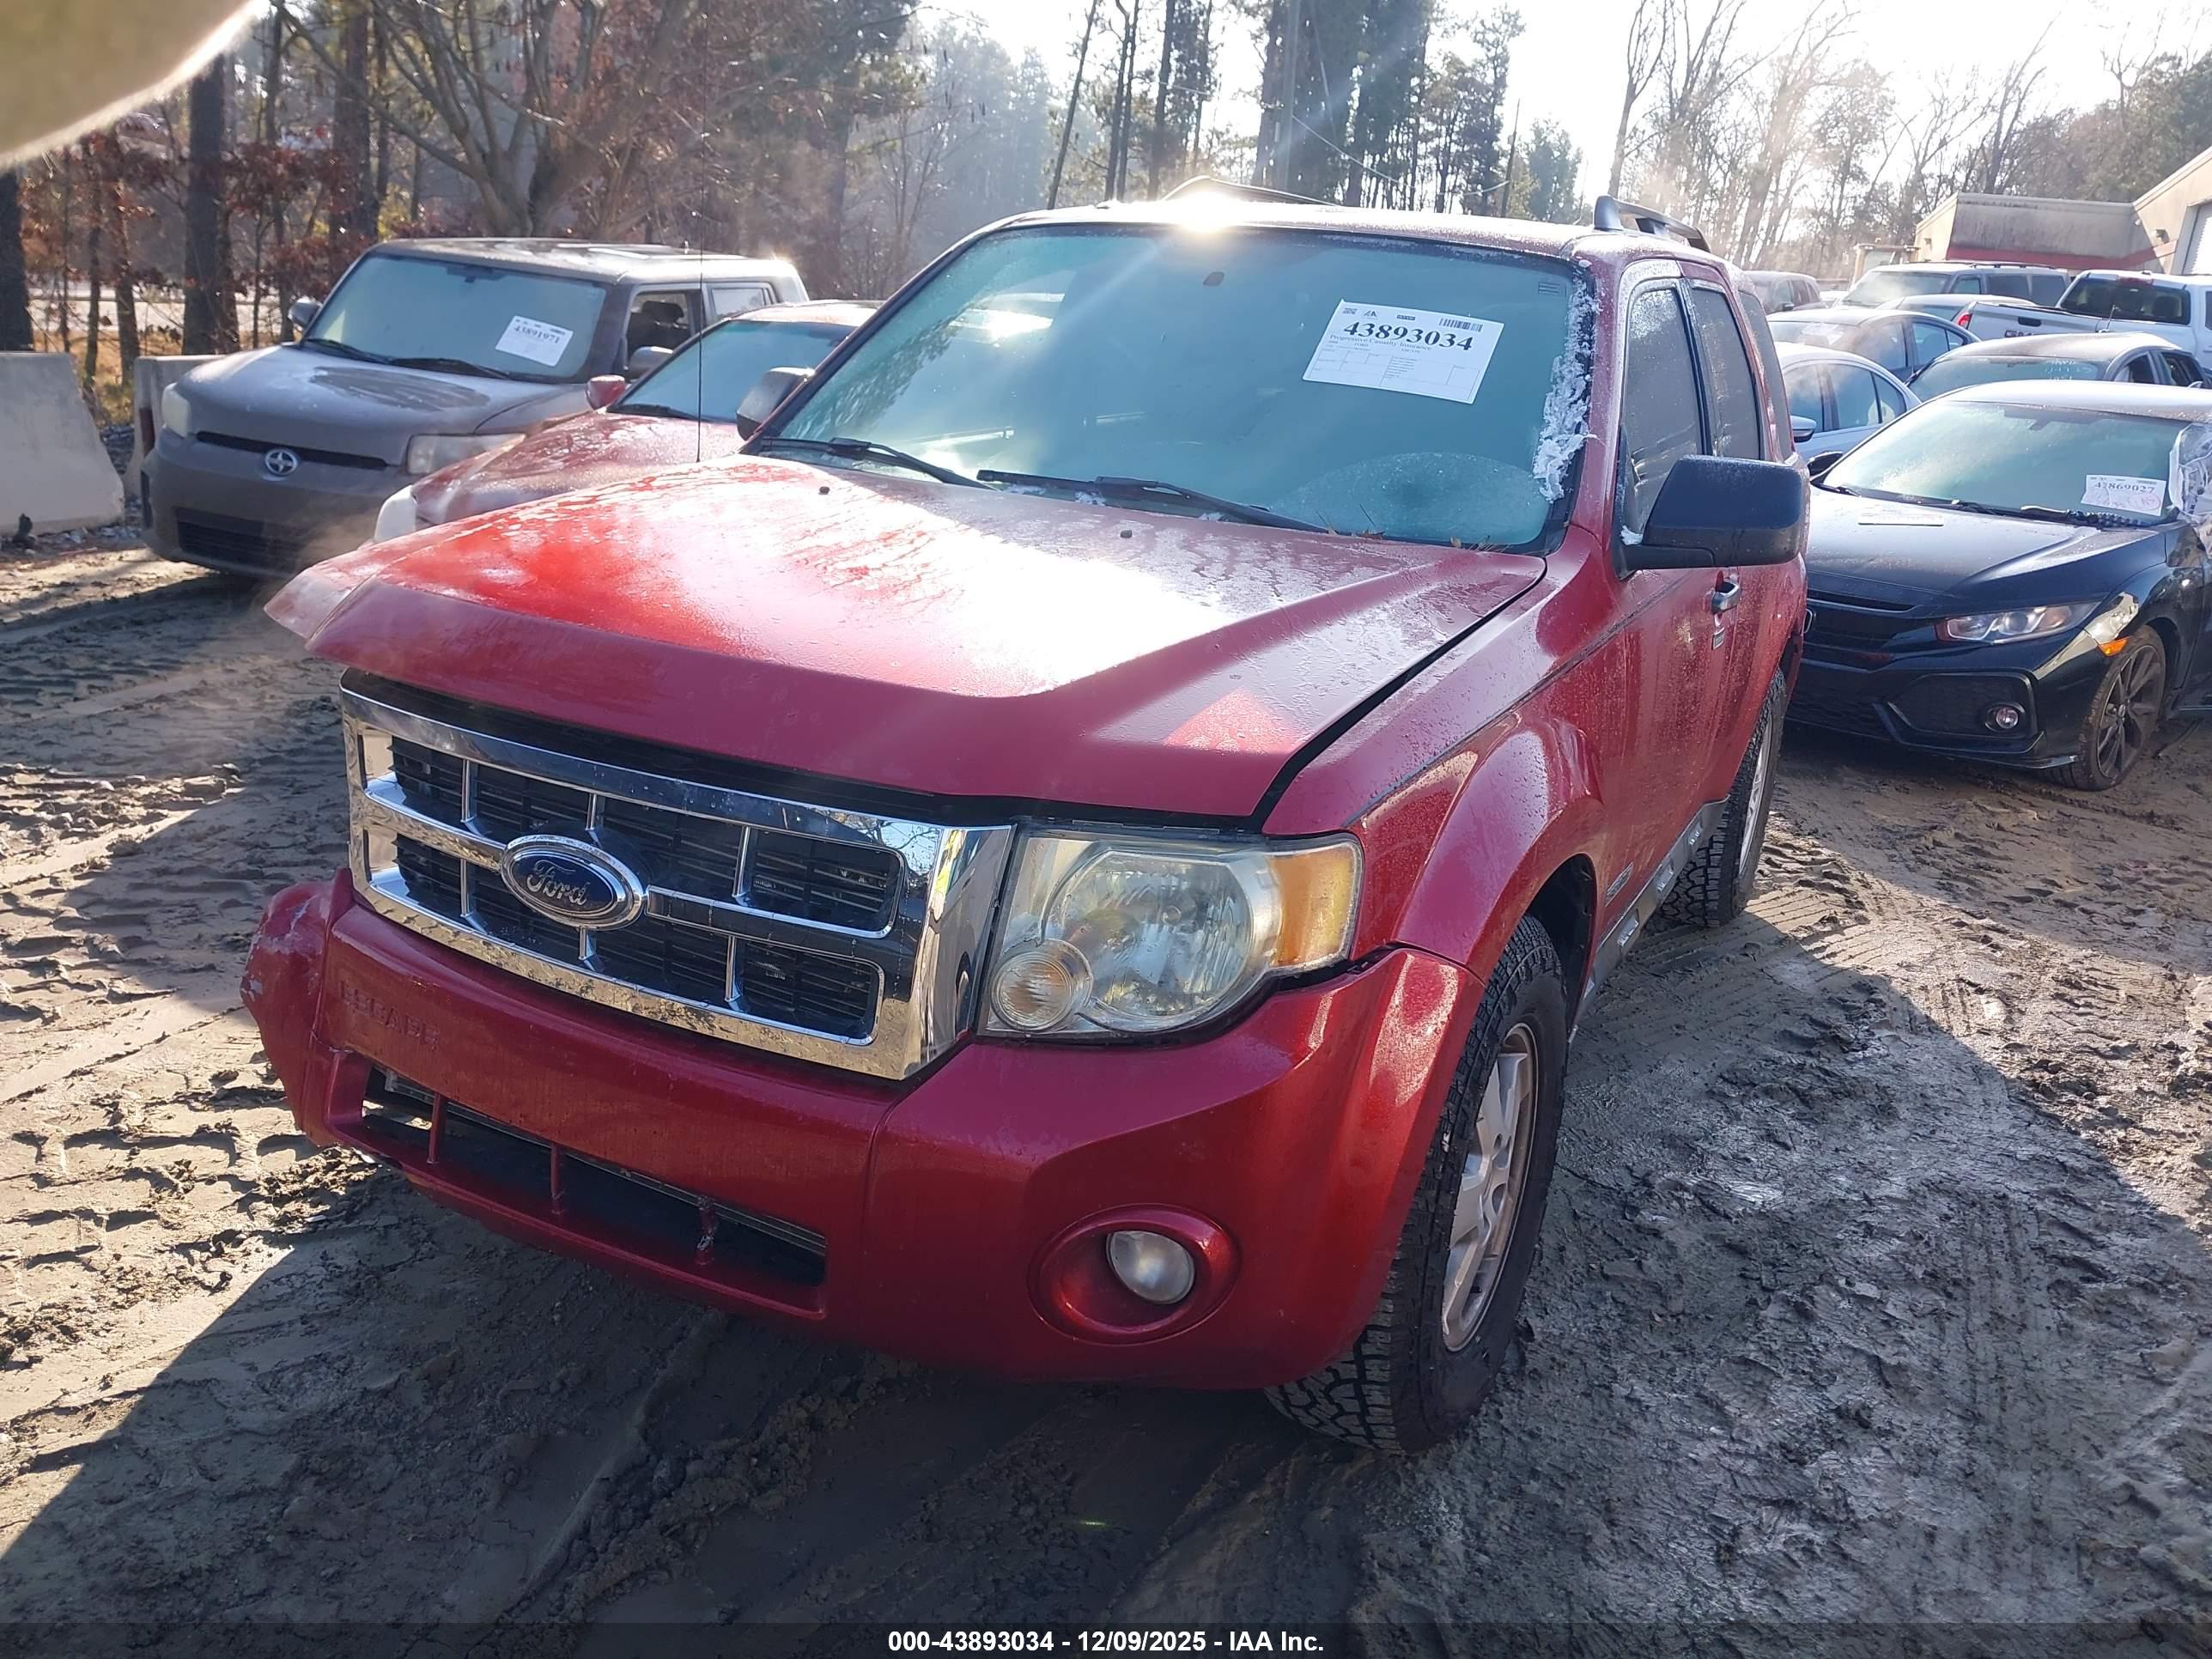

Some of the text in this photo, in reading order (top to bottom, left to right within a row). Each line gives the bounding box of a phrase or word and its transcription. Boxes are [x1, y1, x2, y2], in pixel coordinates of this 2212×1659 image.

[1329, 334, 1368, 343] Progressive
[1400, 341, 1431, 350] Insurance
[1343, 321, 1474, 351] 43893034
[526, 860, 591, 906] Ford
